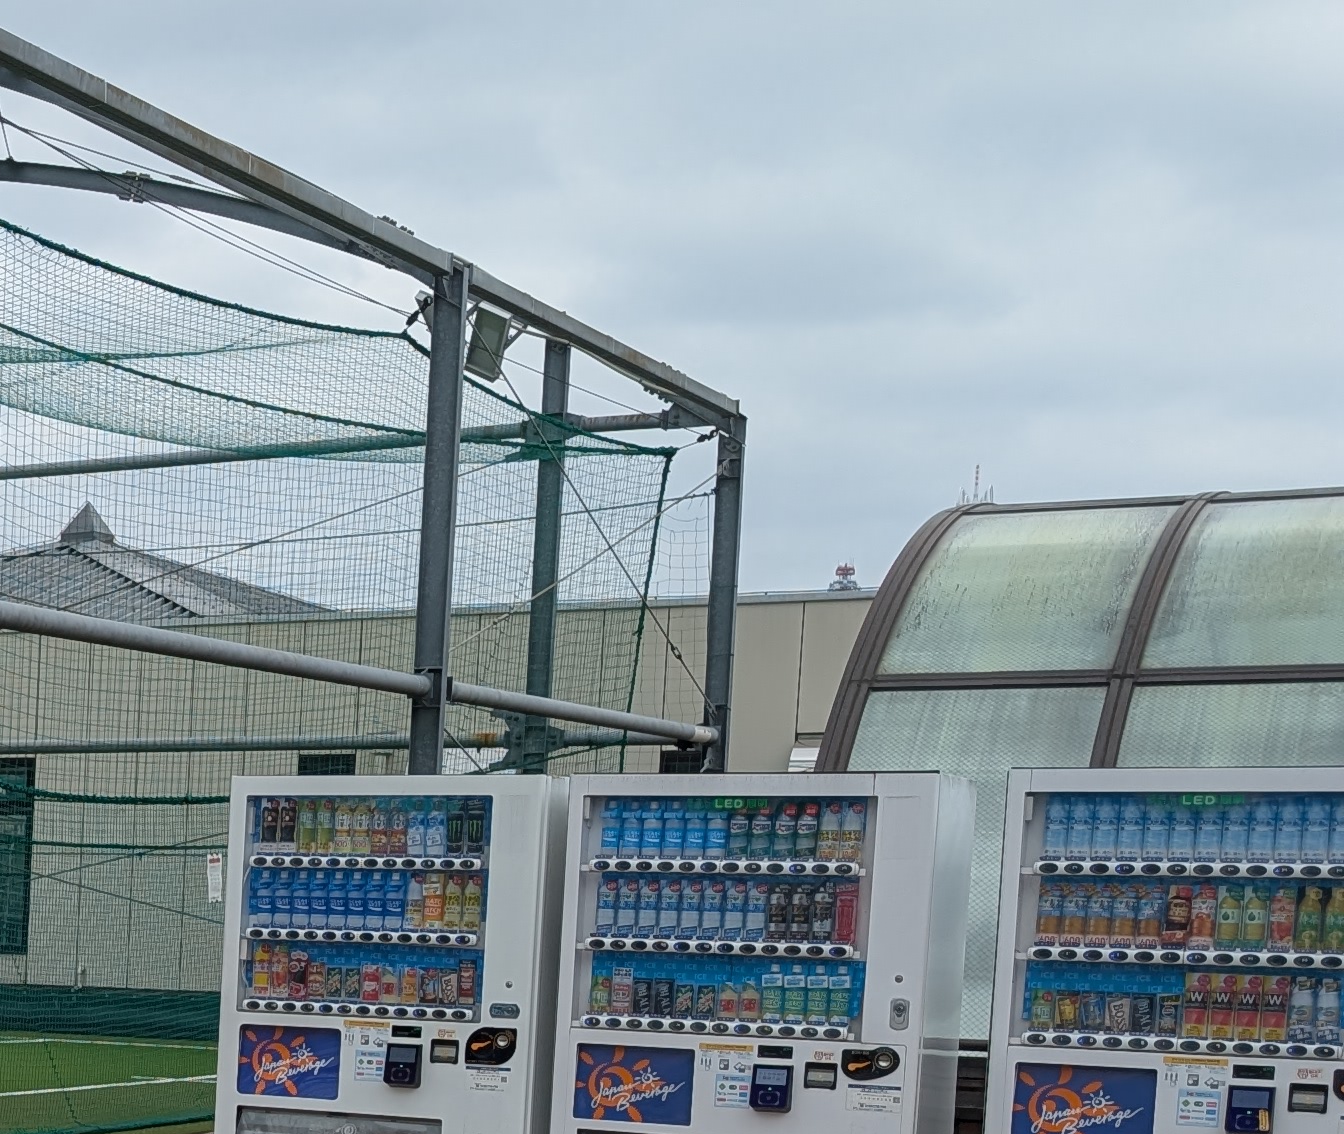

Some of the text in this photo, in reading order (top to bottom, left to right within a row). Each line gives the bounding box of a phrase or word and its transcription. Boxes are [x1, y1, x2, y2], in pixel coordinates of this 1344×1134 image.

[714, 798, 744, 809] LED
[1182, 795, 1216, 806] LED
[442, 978, 456, 1003] BOSS
[1190, 991, 1204, 1002] W
[1216, 992, 1231, 1003] W
[1241, 993, 1256, 1004] W
[1268, 994, 1283, 1005] W
[1113, 1002, 1128, 1032] BOSS
[254, 1057, 294, 1081] Japan
[275, 1057, 335, 1085] Beverage
[591, 1081, 637, 1107] Japan
[616, 1081, 686, 1112] Beverage
[1031, 1105, 1082, 1133] Japan
